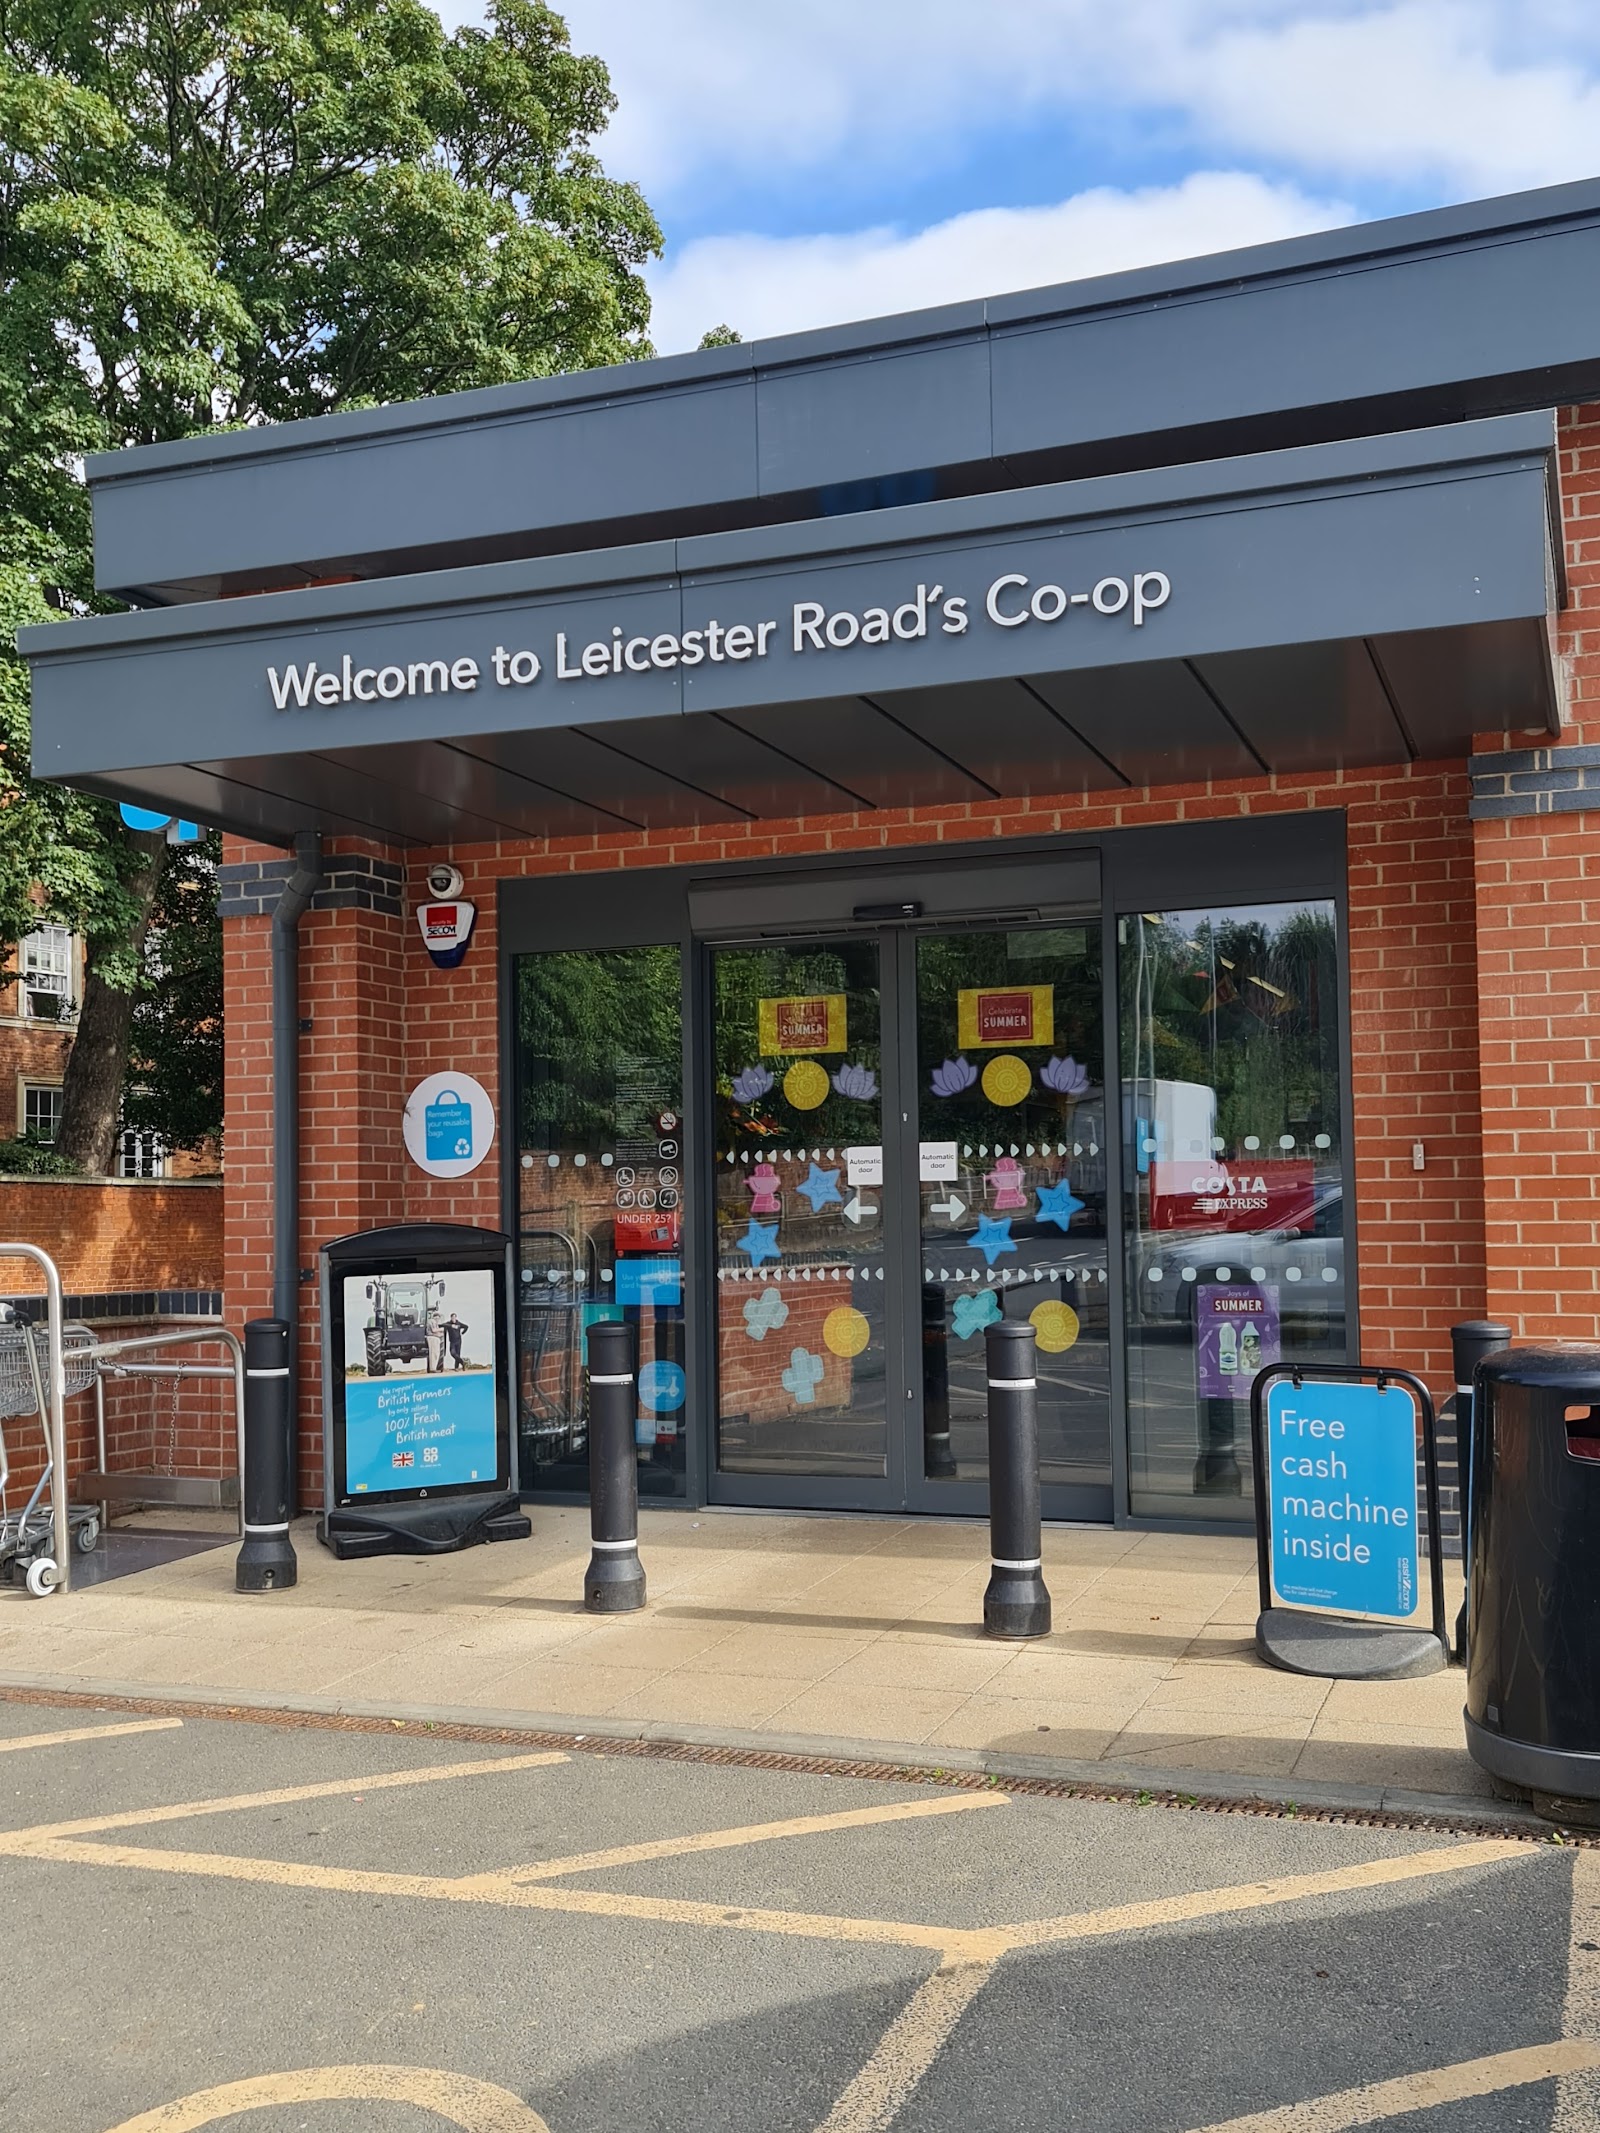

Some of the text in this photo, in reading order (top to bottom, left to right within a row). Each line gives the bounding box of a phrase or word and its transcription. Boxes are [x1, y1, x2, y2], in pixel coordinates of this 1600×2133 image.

[266, 569, 1171, 710] Welcome to Leicester Road's Co-op
[427, 925, 456, 935] SECOM
[988, 1007, 1023, 1015] Celebrate
[983, 1015, 1027, 1028] SUMMER
[782, 1023, 823, 1036] SUMMER
[427, 1109, 462, 1118] Remember
[427, 1118, 470, 1132] your reusable
[427, 1130, 444, 1138] bags
[1191, 1176, 1268, 1196] COSTA
[1210, 1197, 1268, 1210] EXPRESS
[616, 1213, 672, 1224] UNDER 25?
[1227, 1290, 1242, 1298] Joys
[1214, 1299, 1262, 1311] SUMMER
[377, 1386, 453, 1409] British farmers
[385, 1408, 441, 1434] 100% Fresh
[1280, 1409, 1345, 1440] Free
[396, 1421, 457, 1445] British meat
[1281, 1450, 1347, 1480] cash
[1283, 1492, 1409, 1527] machine
[1283, 1529, 1371, 1564] inside
